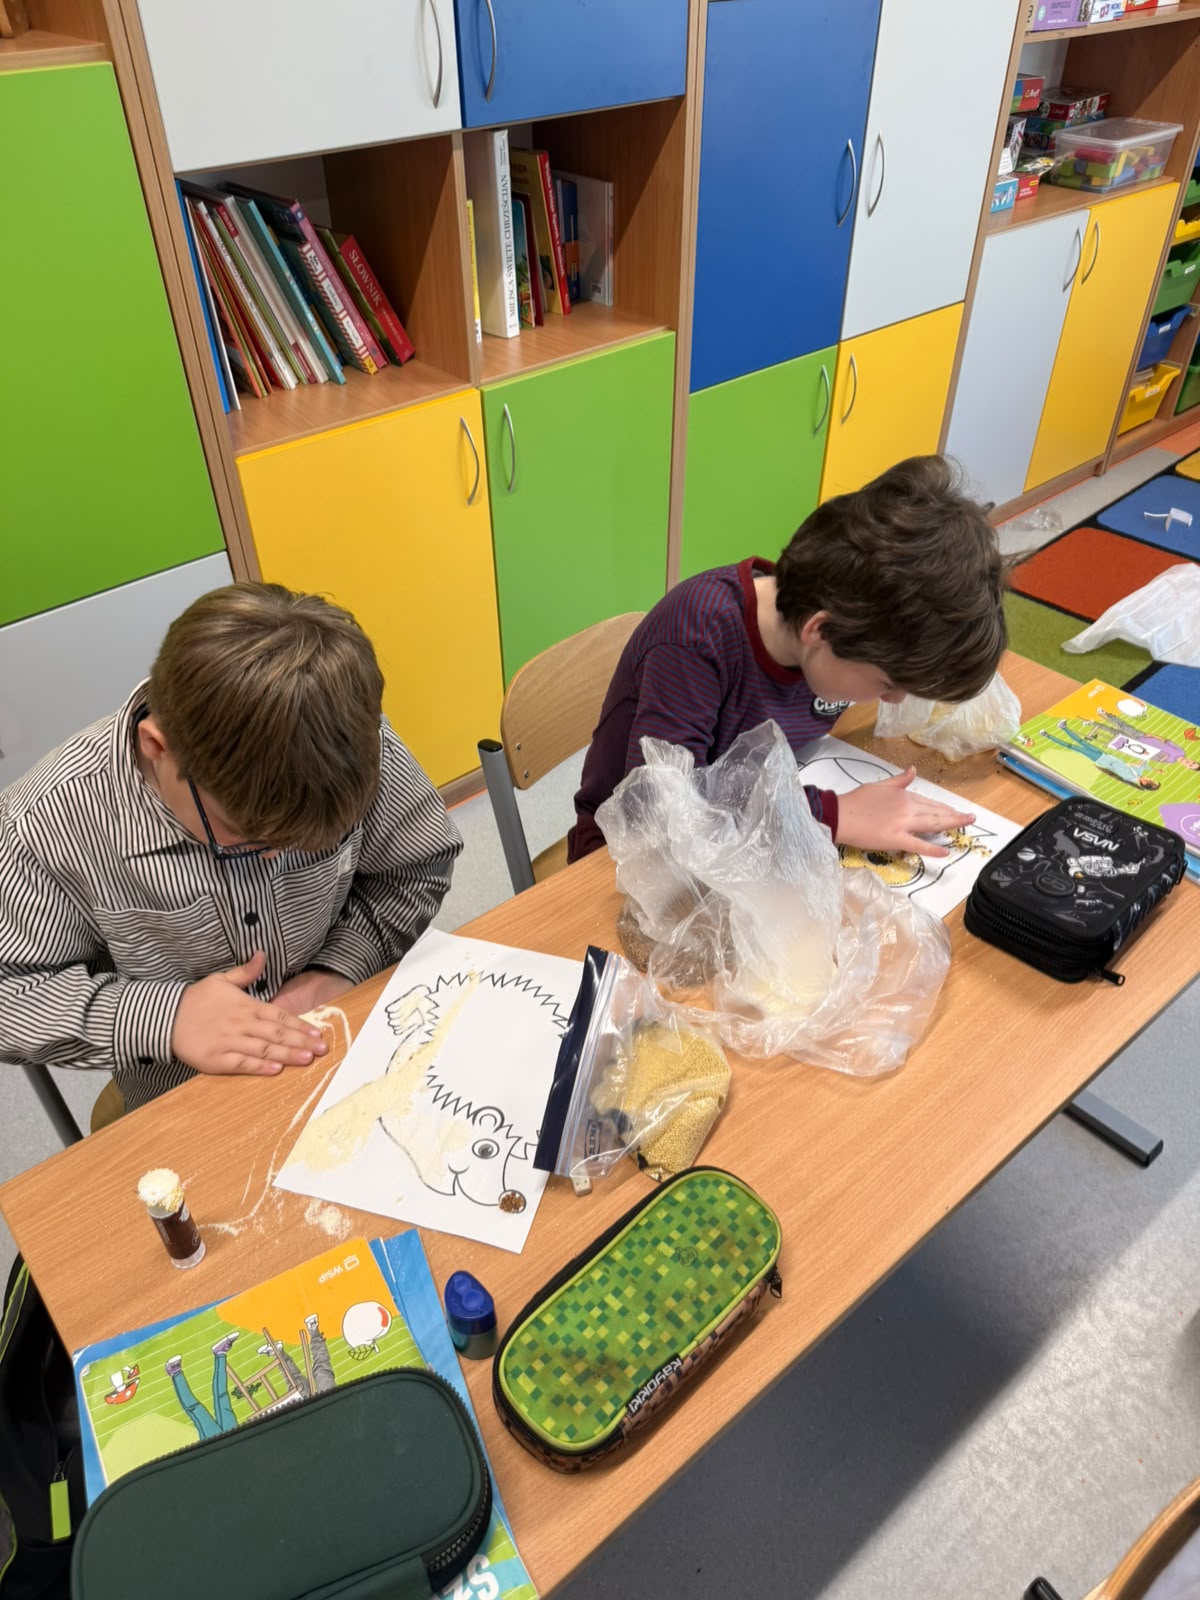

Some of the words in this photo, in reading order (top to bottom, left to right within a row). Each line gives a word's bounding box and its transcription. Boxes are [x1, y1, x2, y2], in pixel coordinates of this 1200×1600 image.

[348, 248, 383, 307] SŁOWNIK
[507, 279, 516, 318] MIEJSCA
[1073, 826, 1120, 851] NASA
[319, 1265, 343, 1283] WSIP
[432, 1553, 500, 1600] SZ
